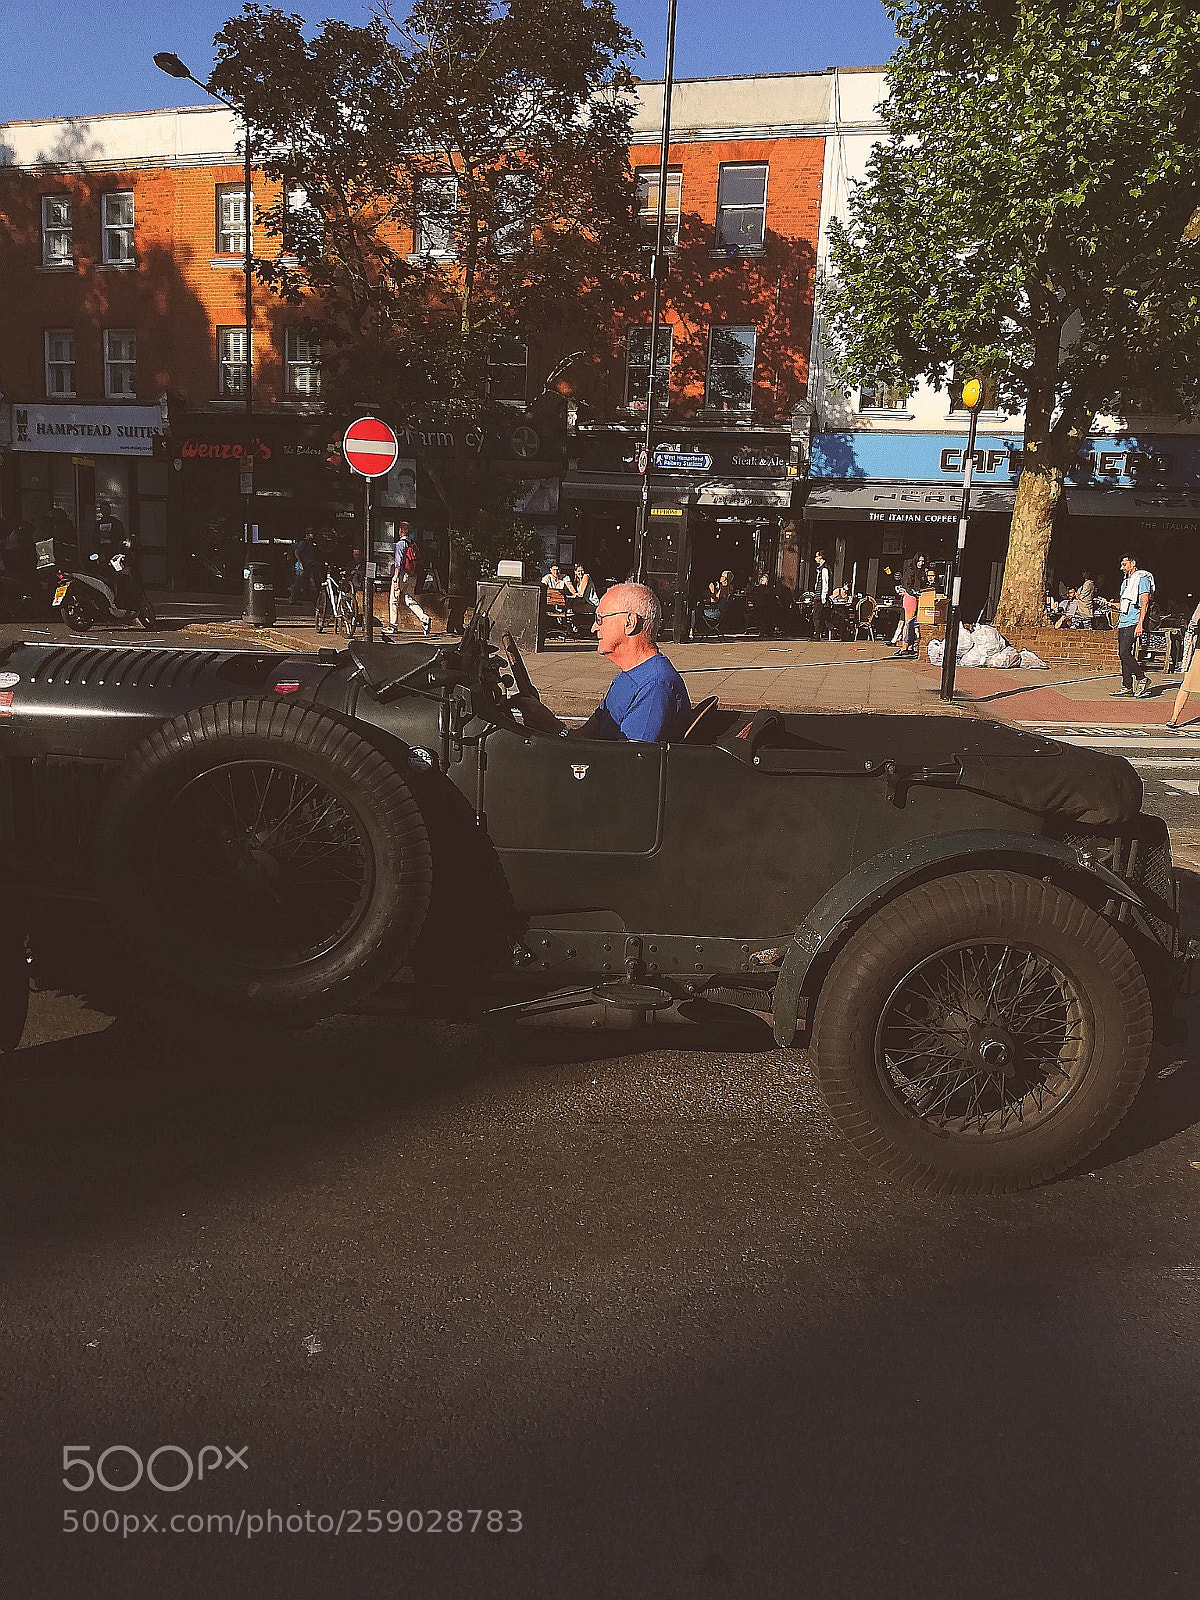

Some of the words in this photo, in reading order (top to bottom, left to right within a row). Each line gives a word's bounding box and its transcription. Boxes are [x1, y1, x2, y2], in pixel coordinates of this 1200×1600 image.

[36, 423, 112, 438] HAMPSTEAD
[116, 426, 161, 439] SUITES
[731, 454, 758, 466] Steak
[767, 455, 785, 466] Ale
[868, 512, 884, 522] THE
[886, 513, 920, 523] ITALIAN
[922, 514, 957, 524] COFFEE
